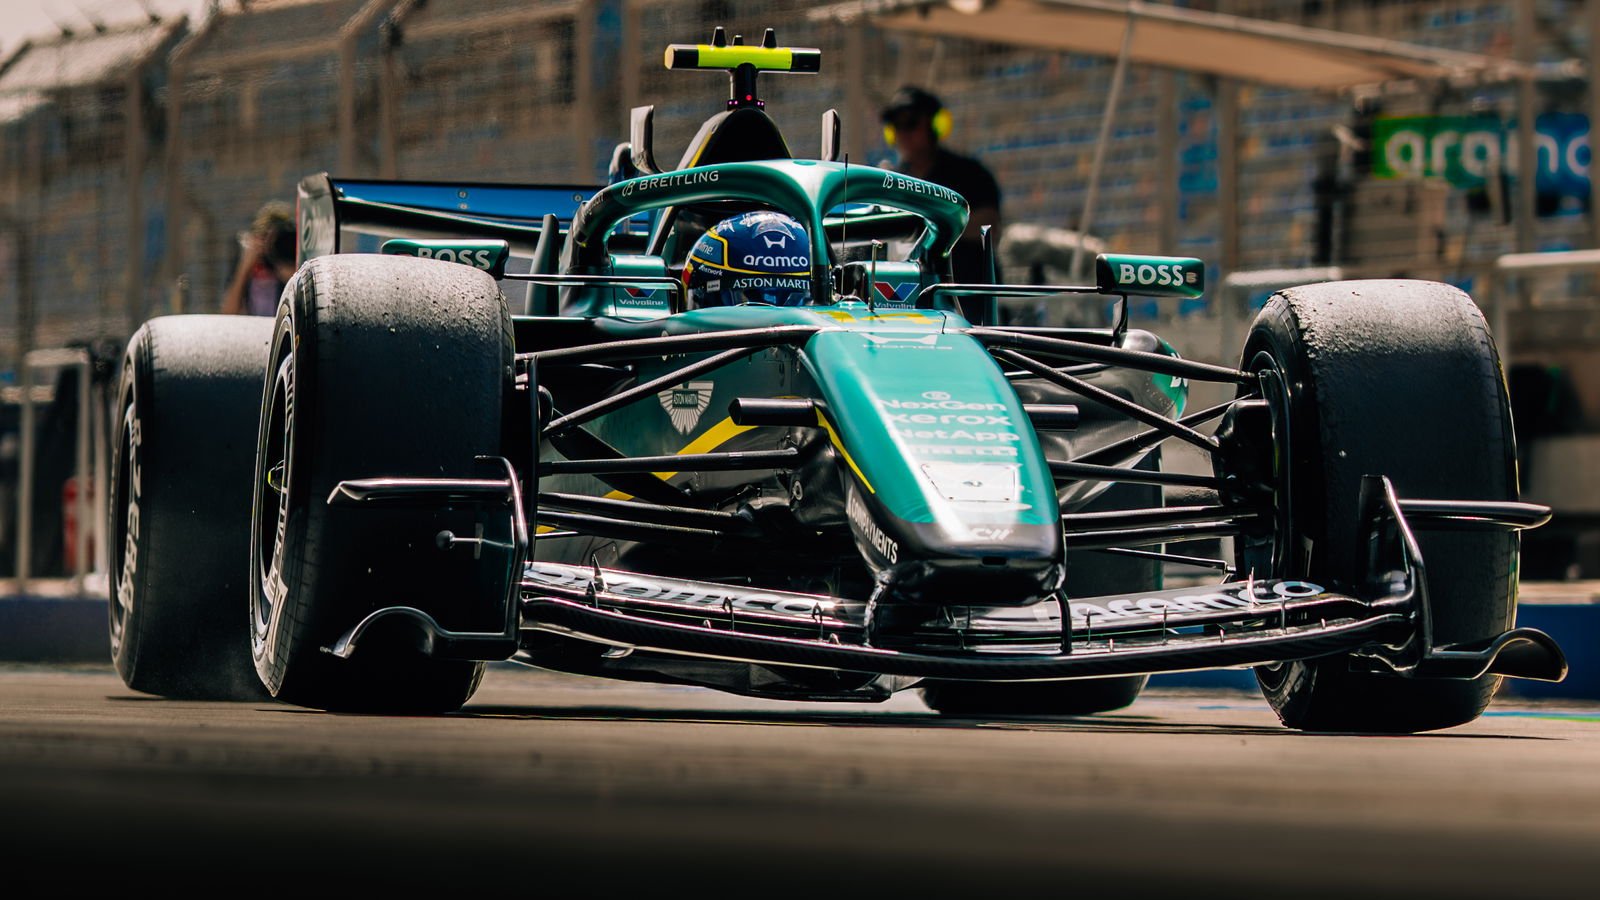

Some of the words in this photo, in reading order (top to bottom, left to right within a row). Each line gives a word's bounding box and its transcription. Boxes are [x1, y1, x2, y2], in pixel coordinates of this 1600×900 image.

[1385, 130, 1591, 178] aramc
[638, 170, 720, 191] BREITLING
[897, 178, 958, 204] BREITLING
[417, 247, 491, 271] BOSS
[743, 254, 809, 267] aramco
[733, 277, 773, 289] ASTON
[775, 278, 810, 290] MARTI
[1119, 263, 1184, 287] BOSS
[873, 301, 916, 309] Valvolin
[880, 399, 1007, 411] NexGen
[888, 413, 1013, 426] xerox
[899, 429, 1020, 442] NetApp
[1068, 578, 1326, 621] aramco
